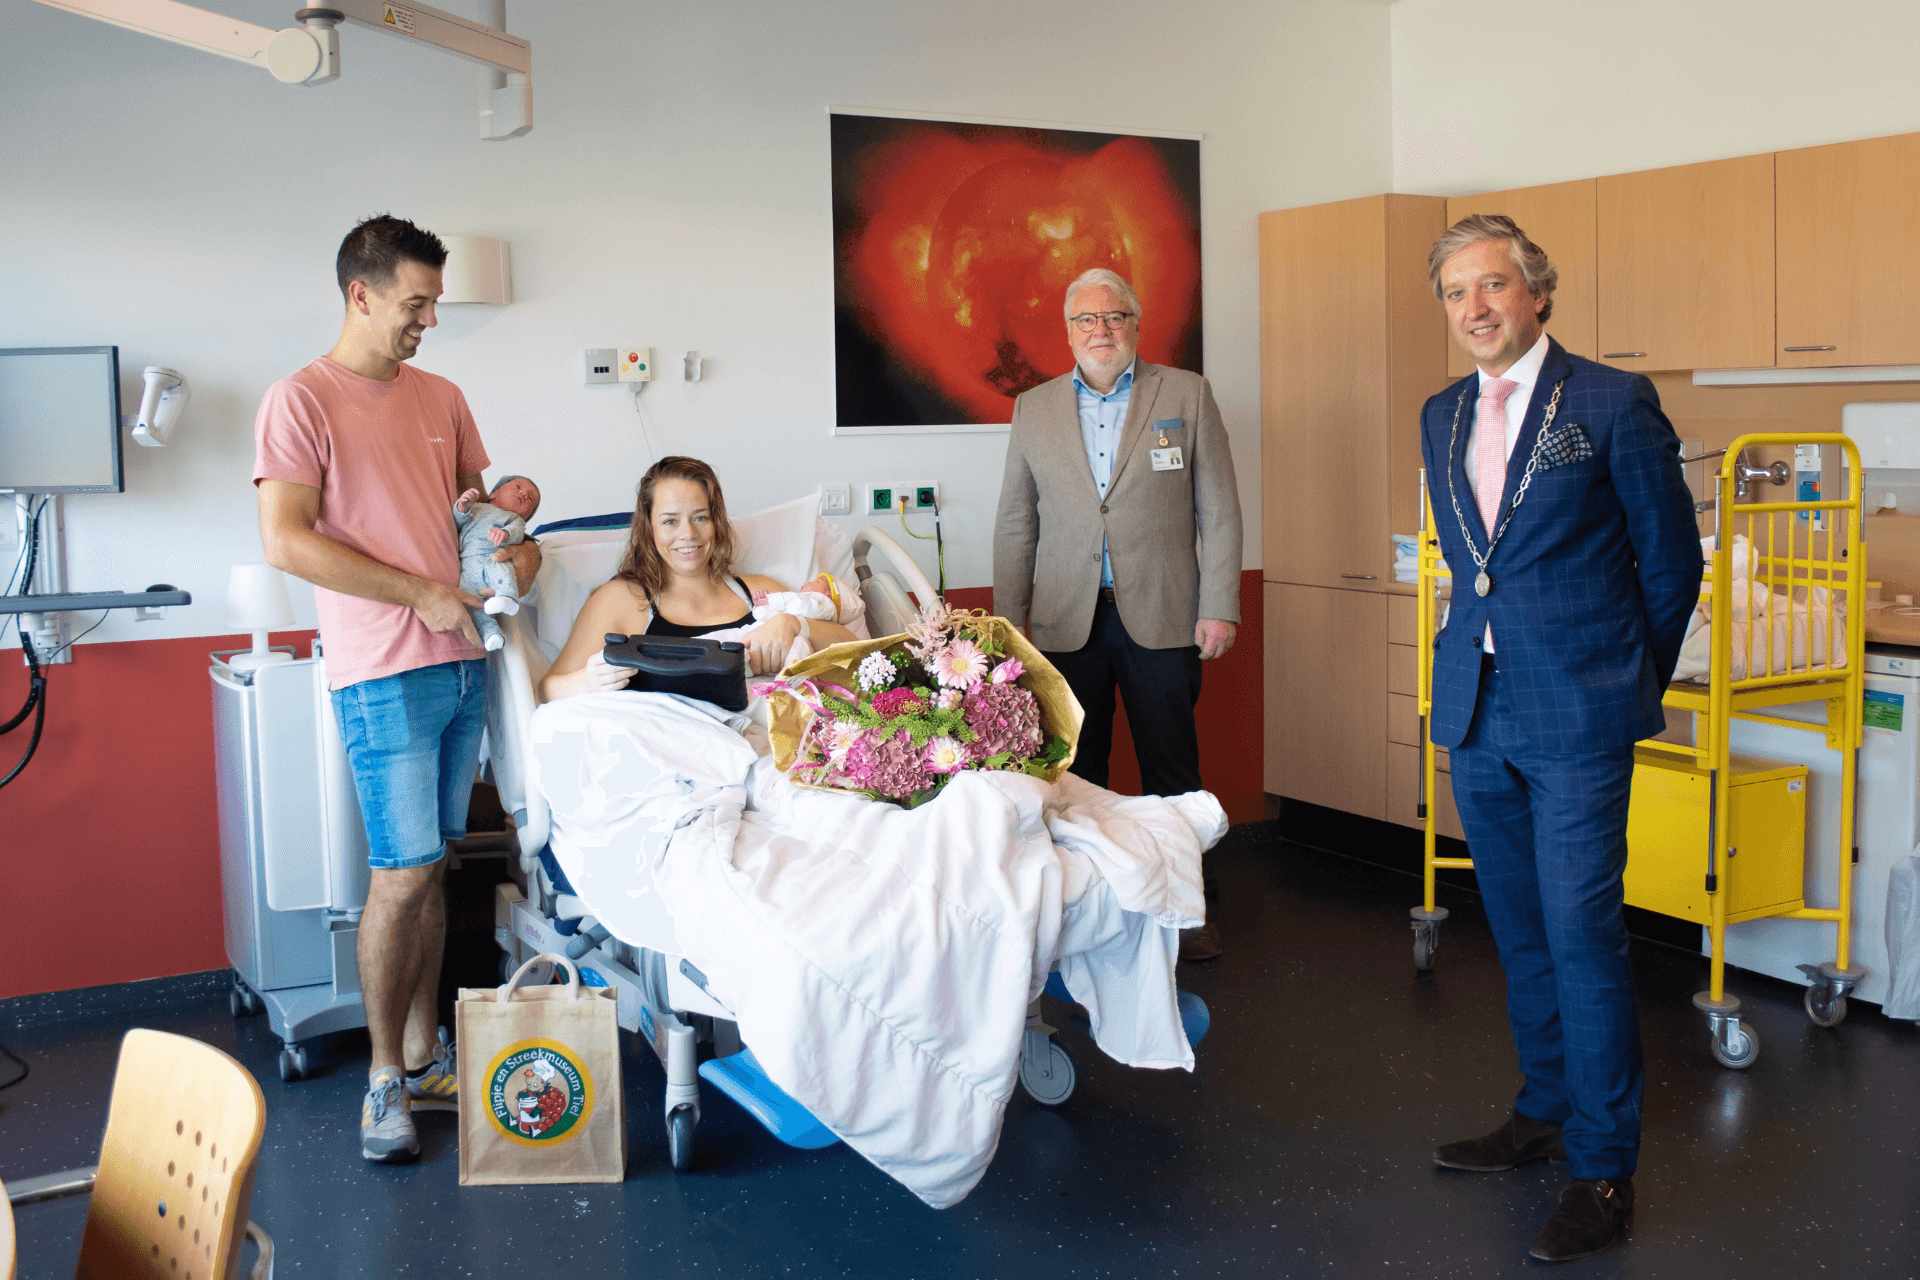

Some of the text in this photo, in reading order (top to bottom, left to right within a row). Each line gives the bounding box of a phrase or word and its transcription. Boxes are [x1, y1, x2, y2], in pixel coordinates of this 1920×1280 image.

[492, 1048, 585, 1118] Flipje en Streekmuseum Tiel
